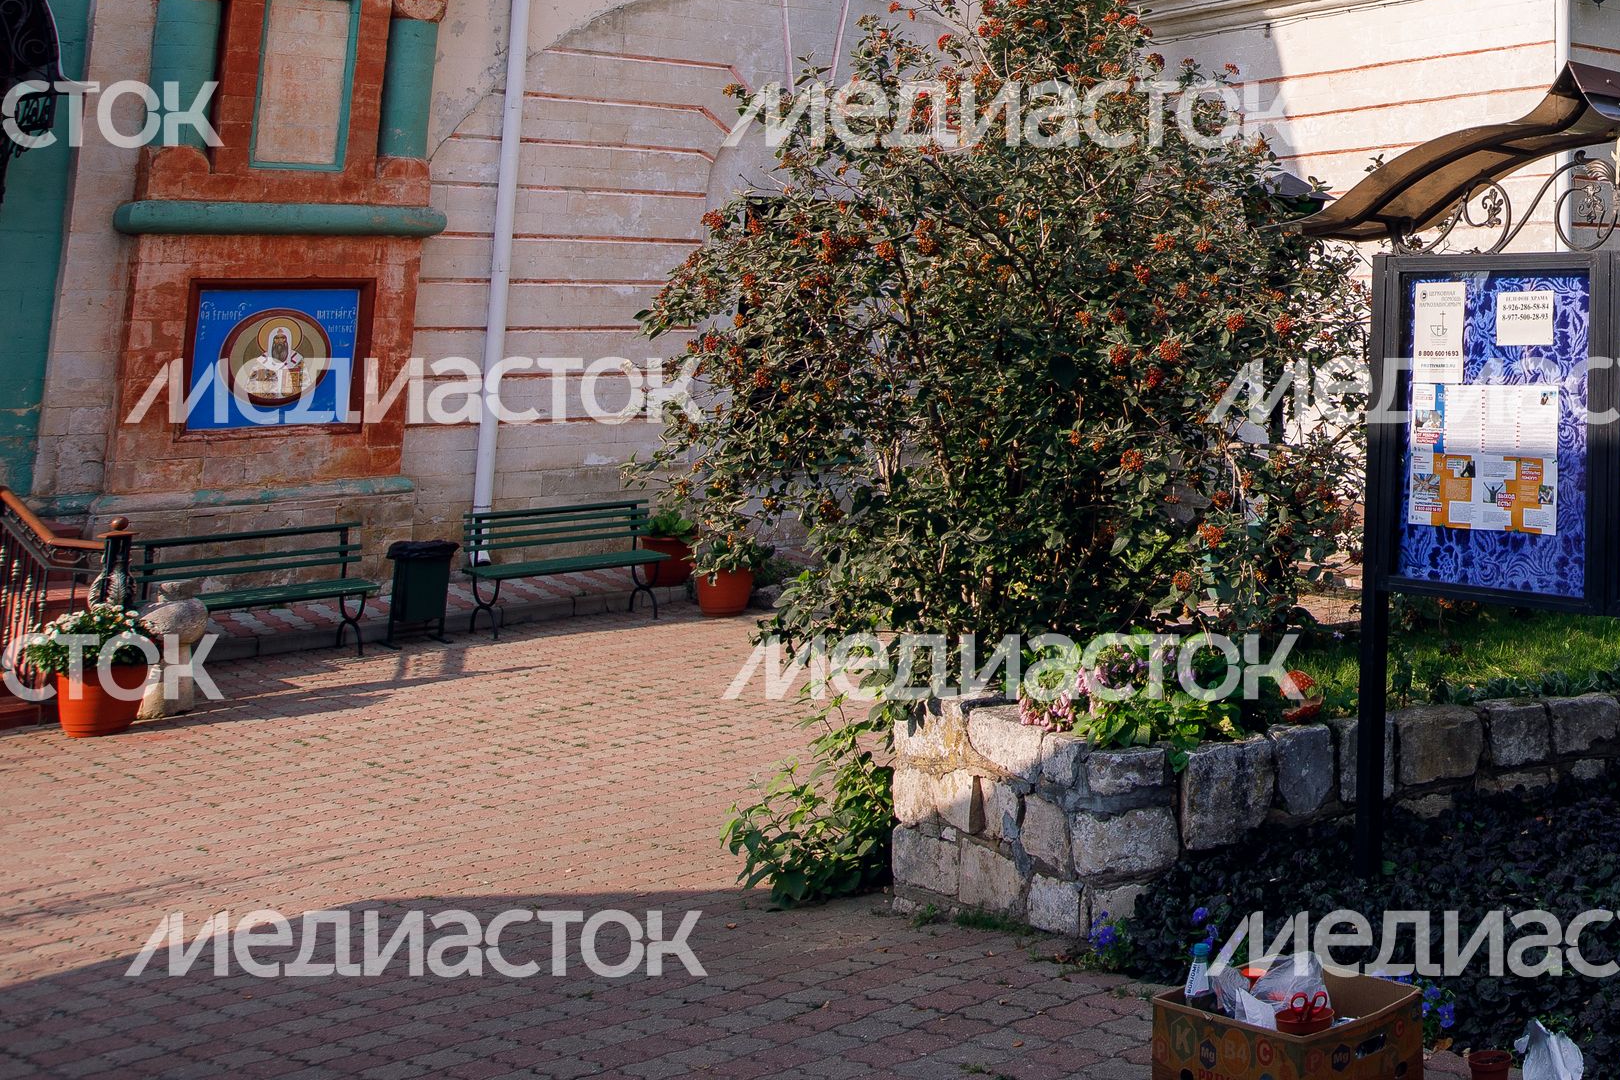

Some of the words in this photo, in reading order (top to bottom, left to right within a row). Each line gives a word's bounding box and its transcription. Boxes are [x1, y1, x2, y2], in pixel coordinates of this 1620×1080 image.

[1187, 963, 1197, 994] BORJOMI
[1176, 1024, 1192, 1053] K
[1201, 1046, 1216, 1063] Mg
[1259, 1043, 1272, 1062] C
[1333, 1052, 1350, 1064] Mg
